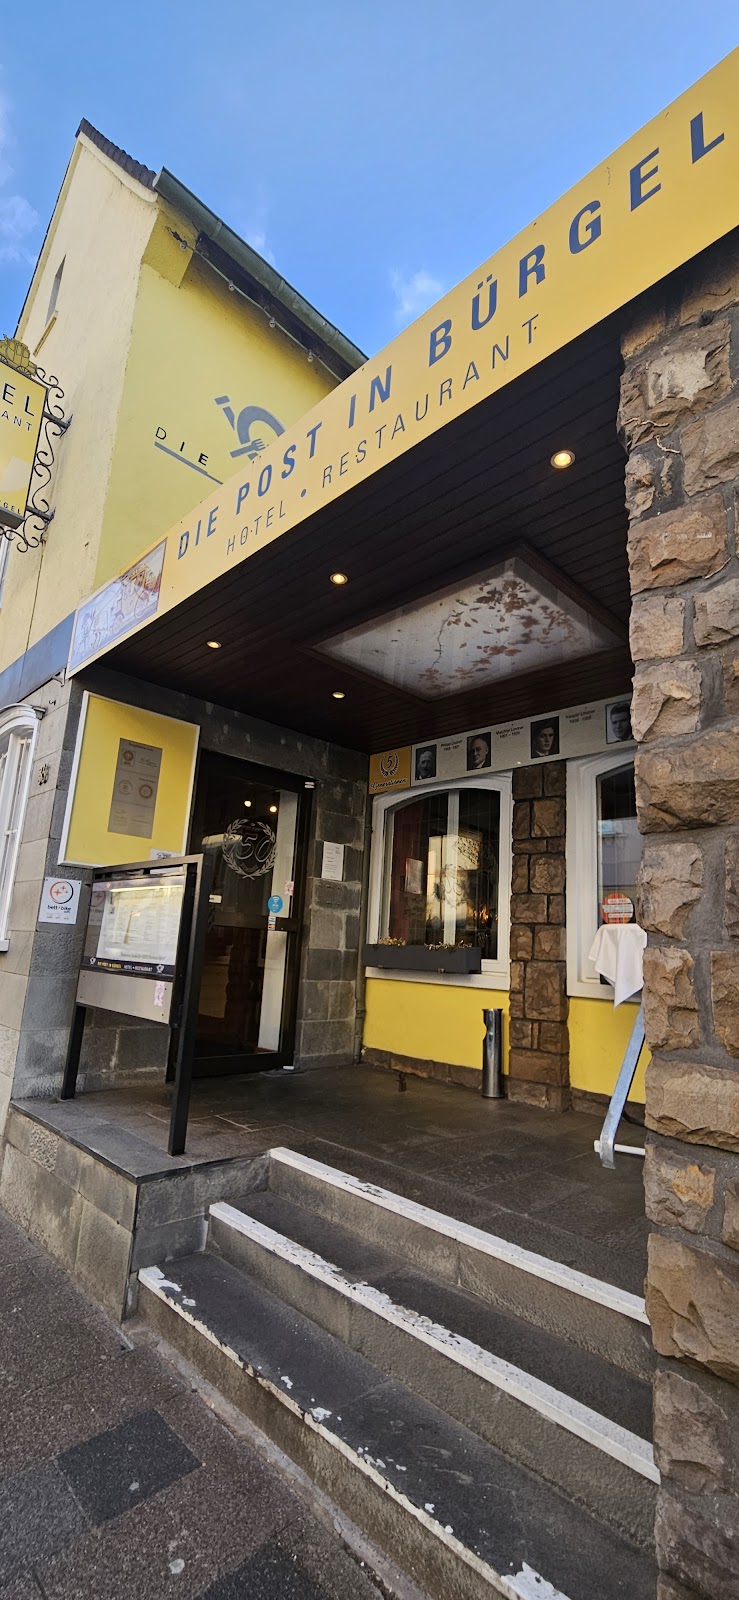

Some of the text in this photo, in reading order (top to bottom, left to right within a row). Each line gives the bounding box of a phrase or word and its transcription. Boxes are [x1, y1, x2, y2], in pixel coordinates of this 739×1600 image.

[155, 426, 209, 466] DIE
[176, 111, 725, 560] DIE POST IN BÜRGEL
[226, 313, 539, 556] HOTEL RESTAURANT
